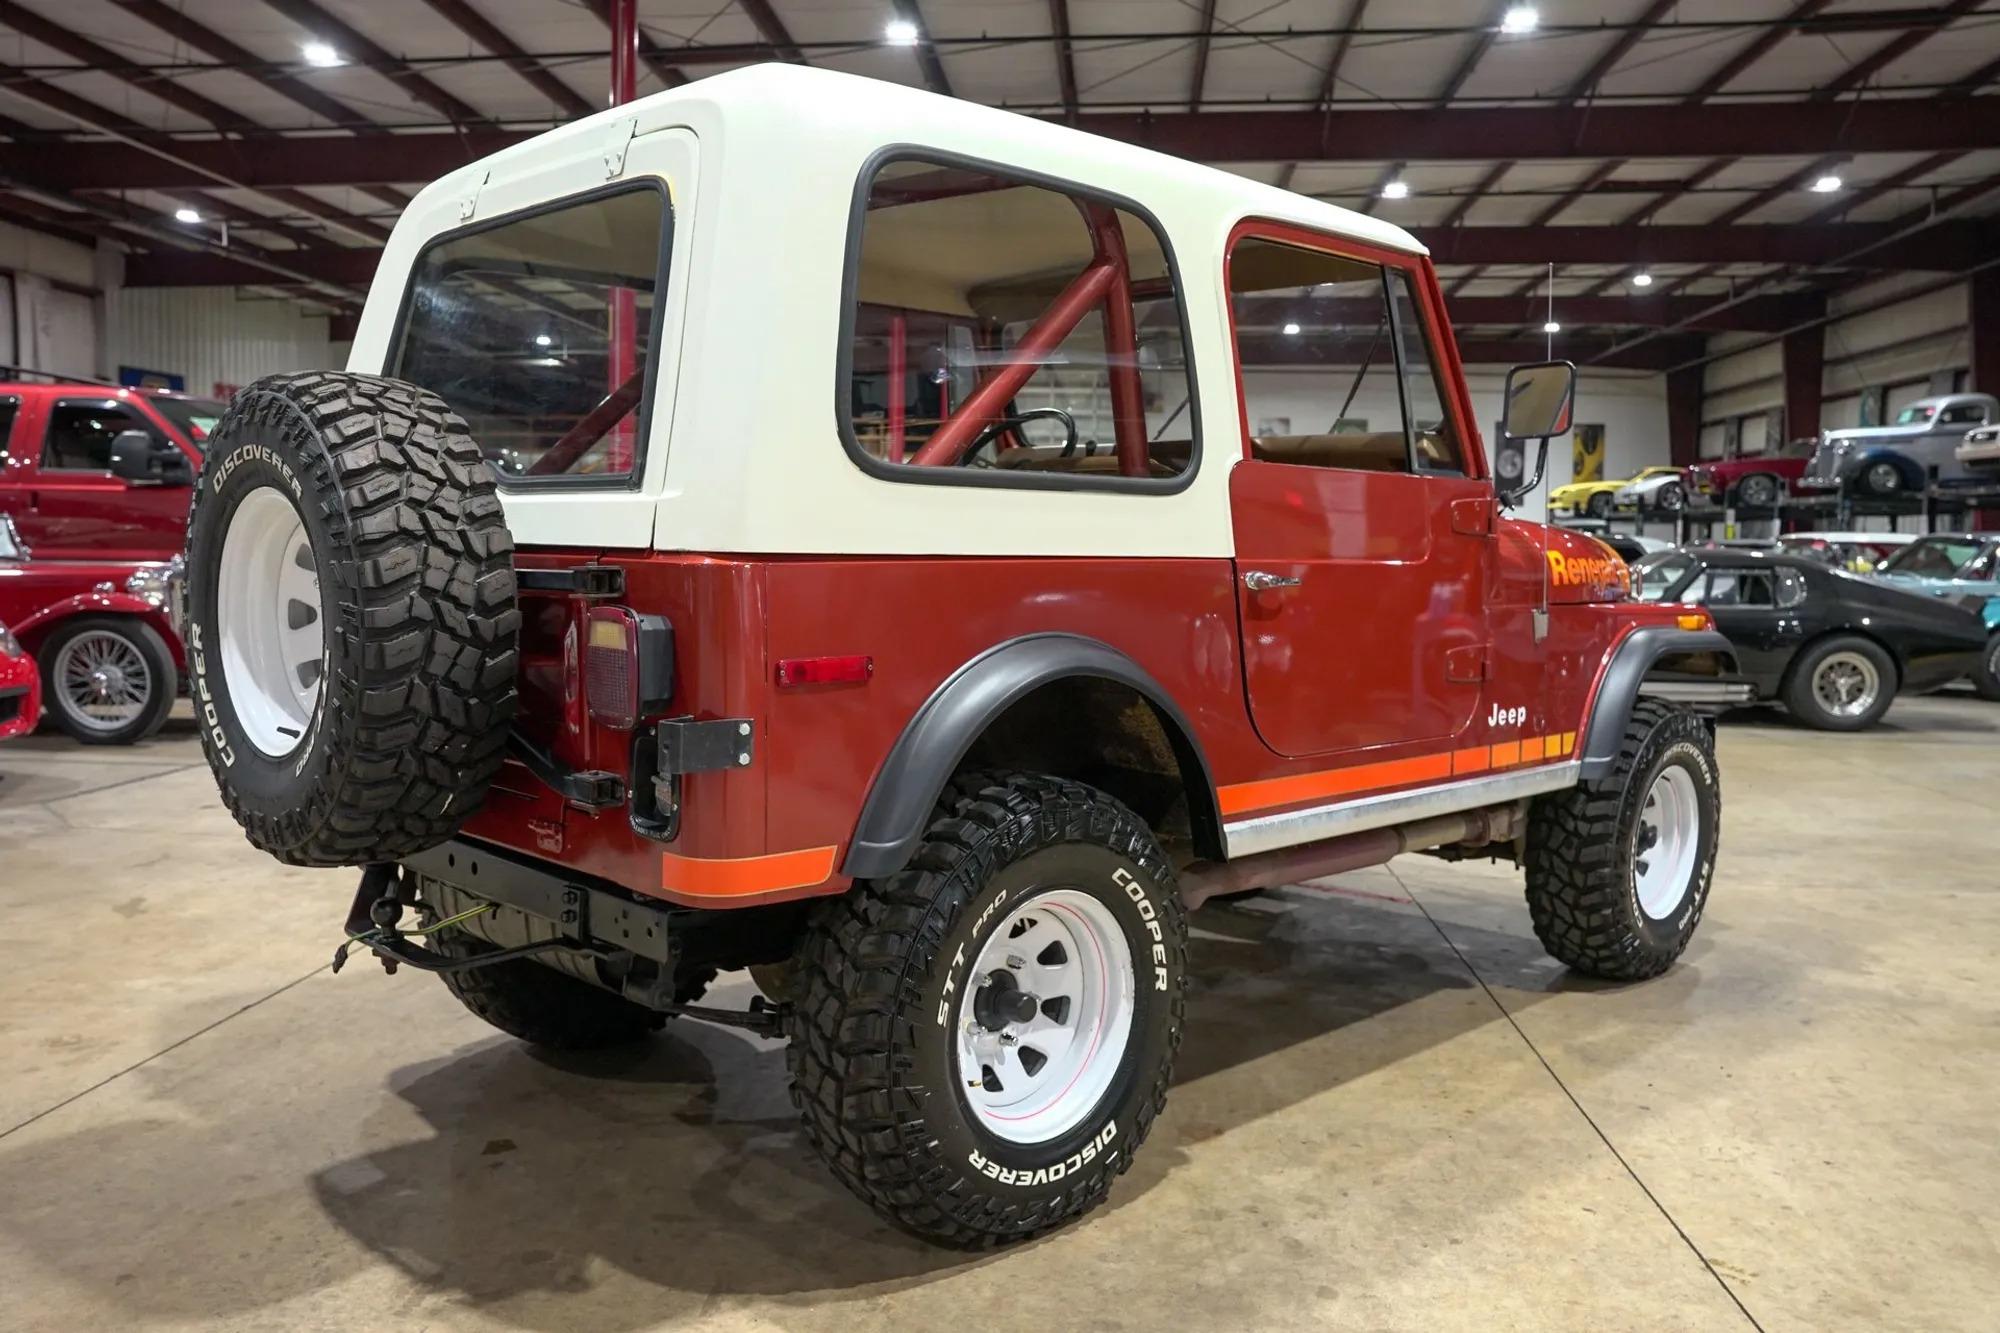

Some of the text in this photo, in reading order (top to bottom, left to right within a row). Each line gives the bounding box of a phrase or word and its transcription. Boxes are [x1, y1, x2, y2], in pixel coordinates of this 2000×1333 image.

[213, 444, 302, 502] DISCOVERER
[191, 622, 235, 768] COOPER
[1487, 702, 1527, 728] Jeep
[936, 888, 1009, 1029] STT PRO
[1110, 866, 1169, 993] COOPER
[967, 1118, 1118, 1187] DISCOVERER
